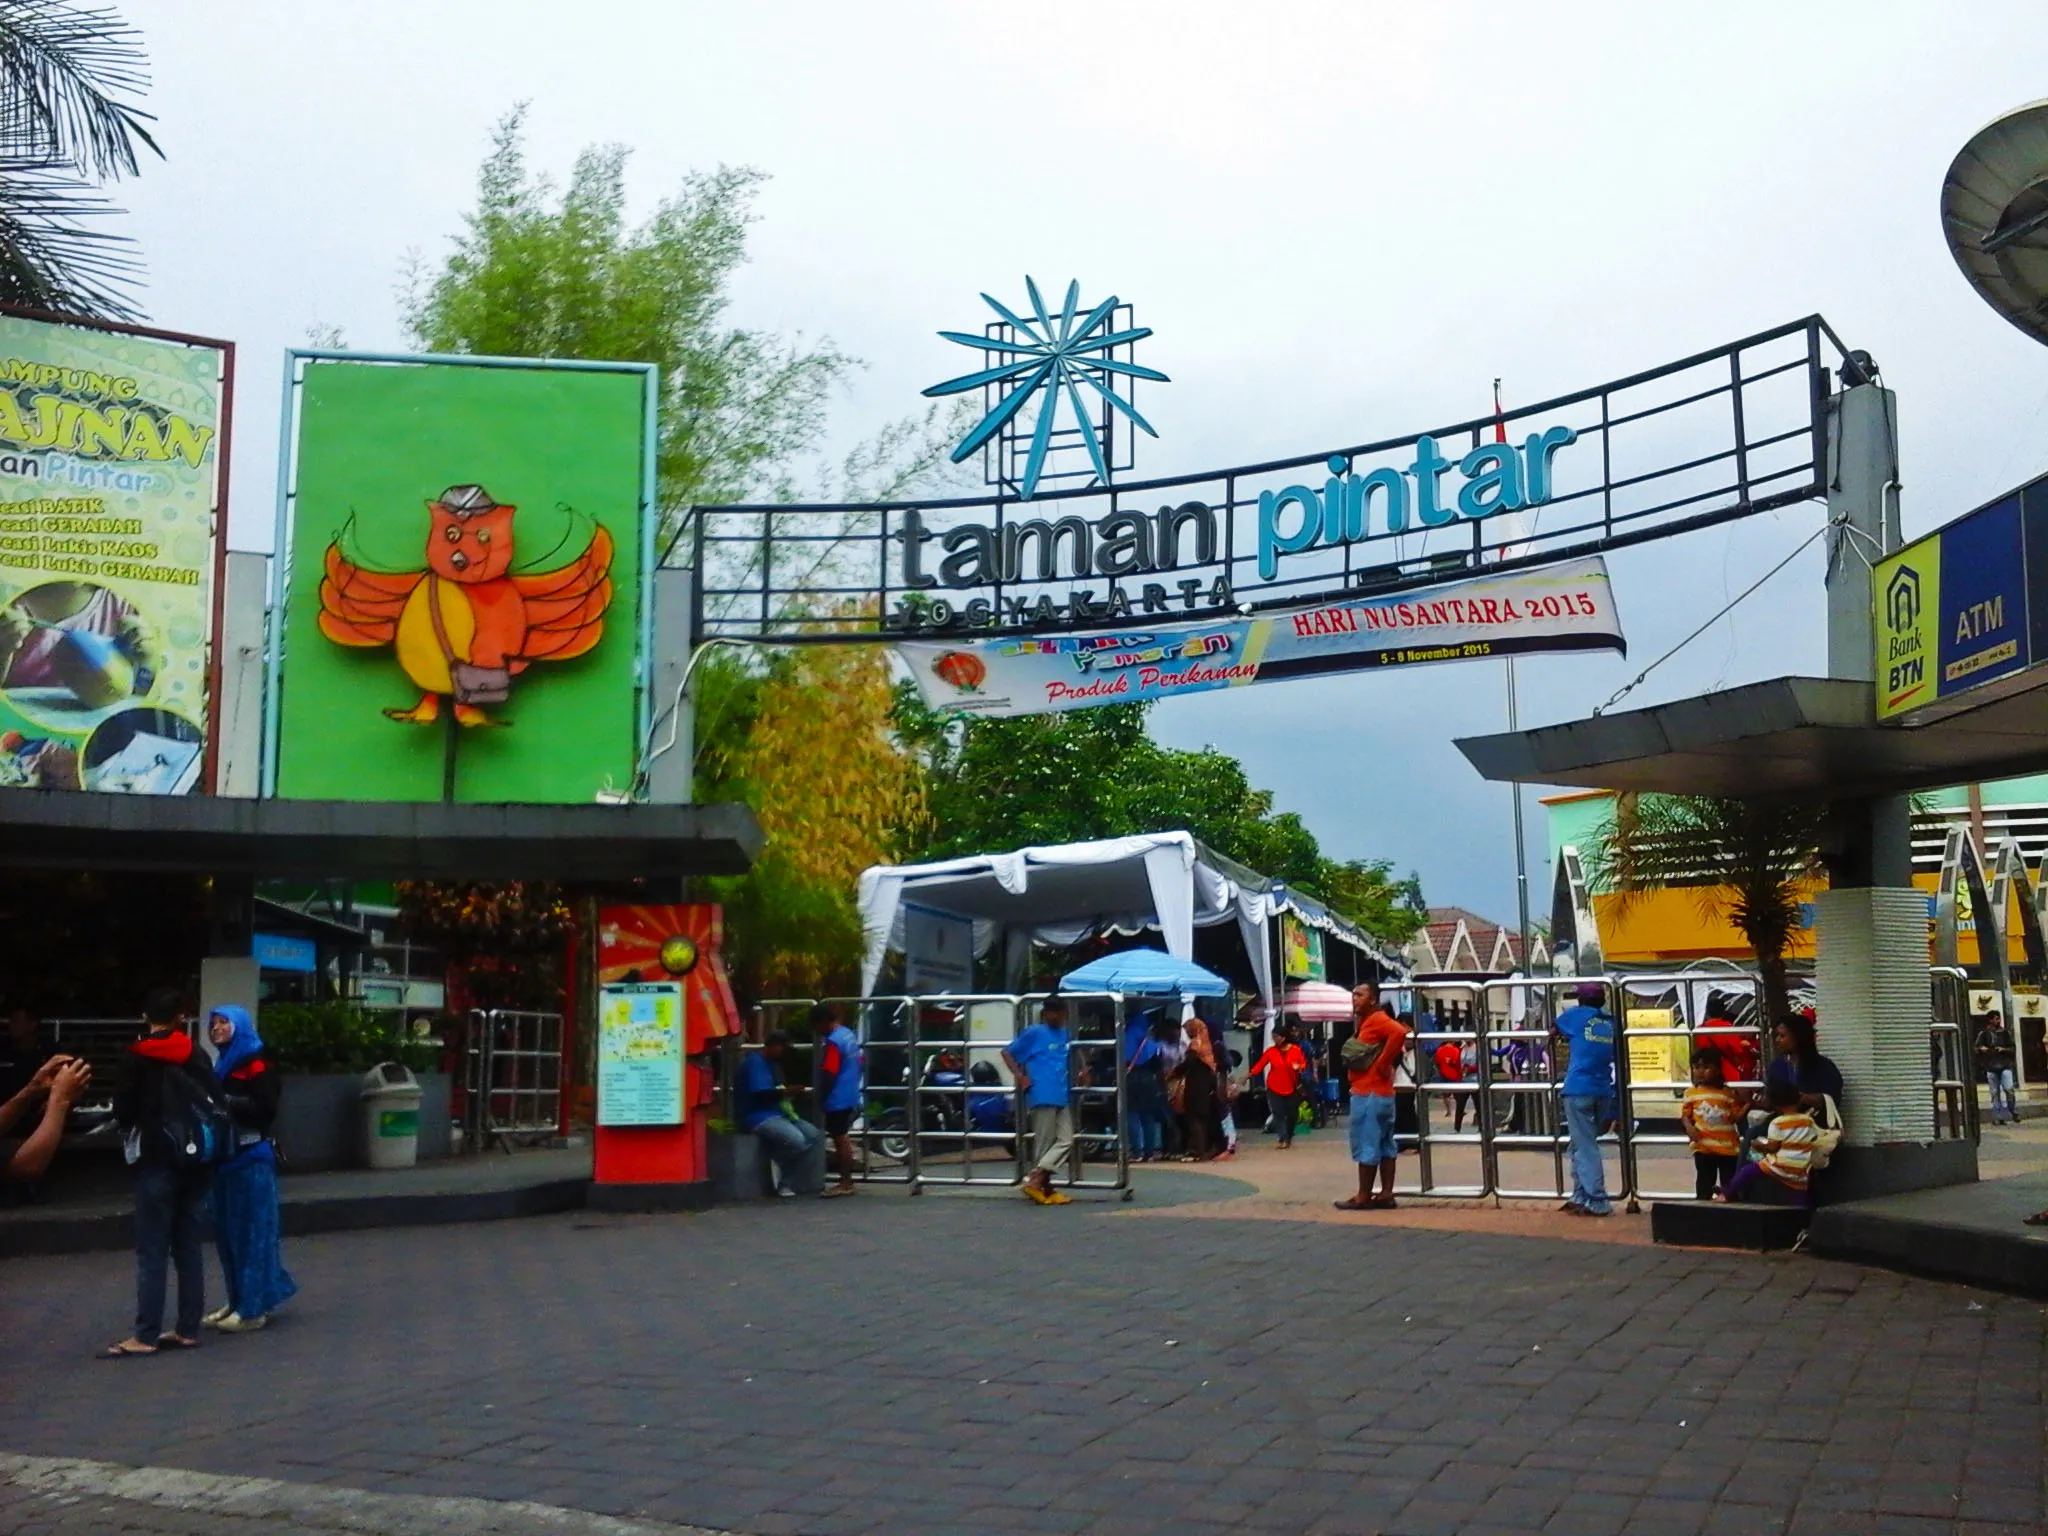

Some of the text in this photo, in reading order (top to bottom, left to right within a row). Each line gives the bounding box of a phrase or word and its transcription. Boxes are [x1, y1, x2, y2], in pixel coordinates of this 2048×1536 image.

[46, 452, 153, 493] Pintar
[41, 498, 105, 514] BATIK
[41, 517, 142, 534] GERABAH
[895, 425, 1578, 589] taman pintar
[100, 541, 158, 558] KAOS
[100, 561, 200, 585] GERABAH
[892, 575, 1235, 629] YOGYAKARTA
[1293, 592, 1596, 638] HARI NUSANTARA 2015
[1955, 595, 2004, 645] ATM
[1380, 653, 1388, 664] 5
[1407, 647, 1461, 662] November
[1462, 643, 1491, 656] 2015
[1888, 628, 1922, 661] Bank
[1045, 662, 1256, 703] Produk Perikanan
[1888, 655, 1924, 694] BTN
